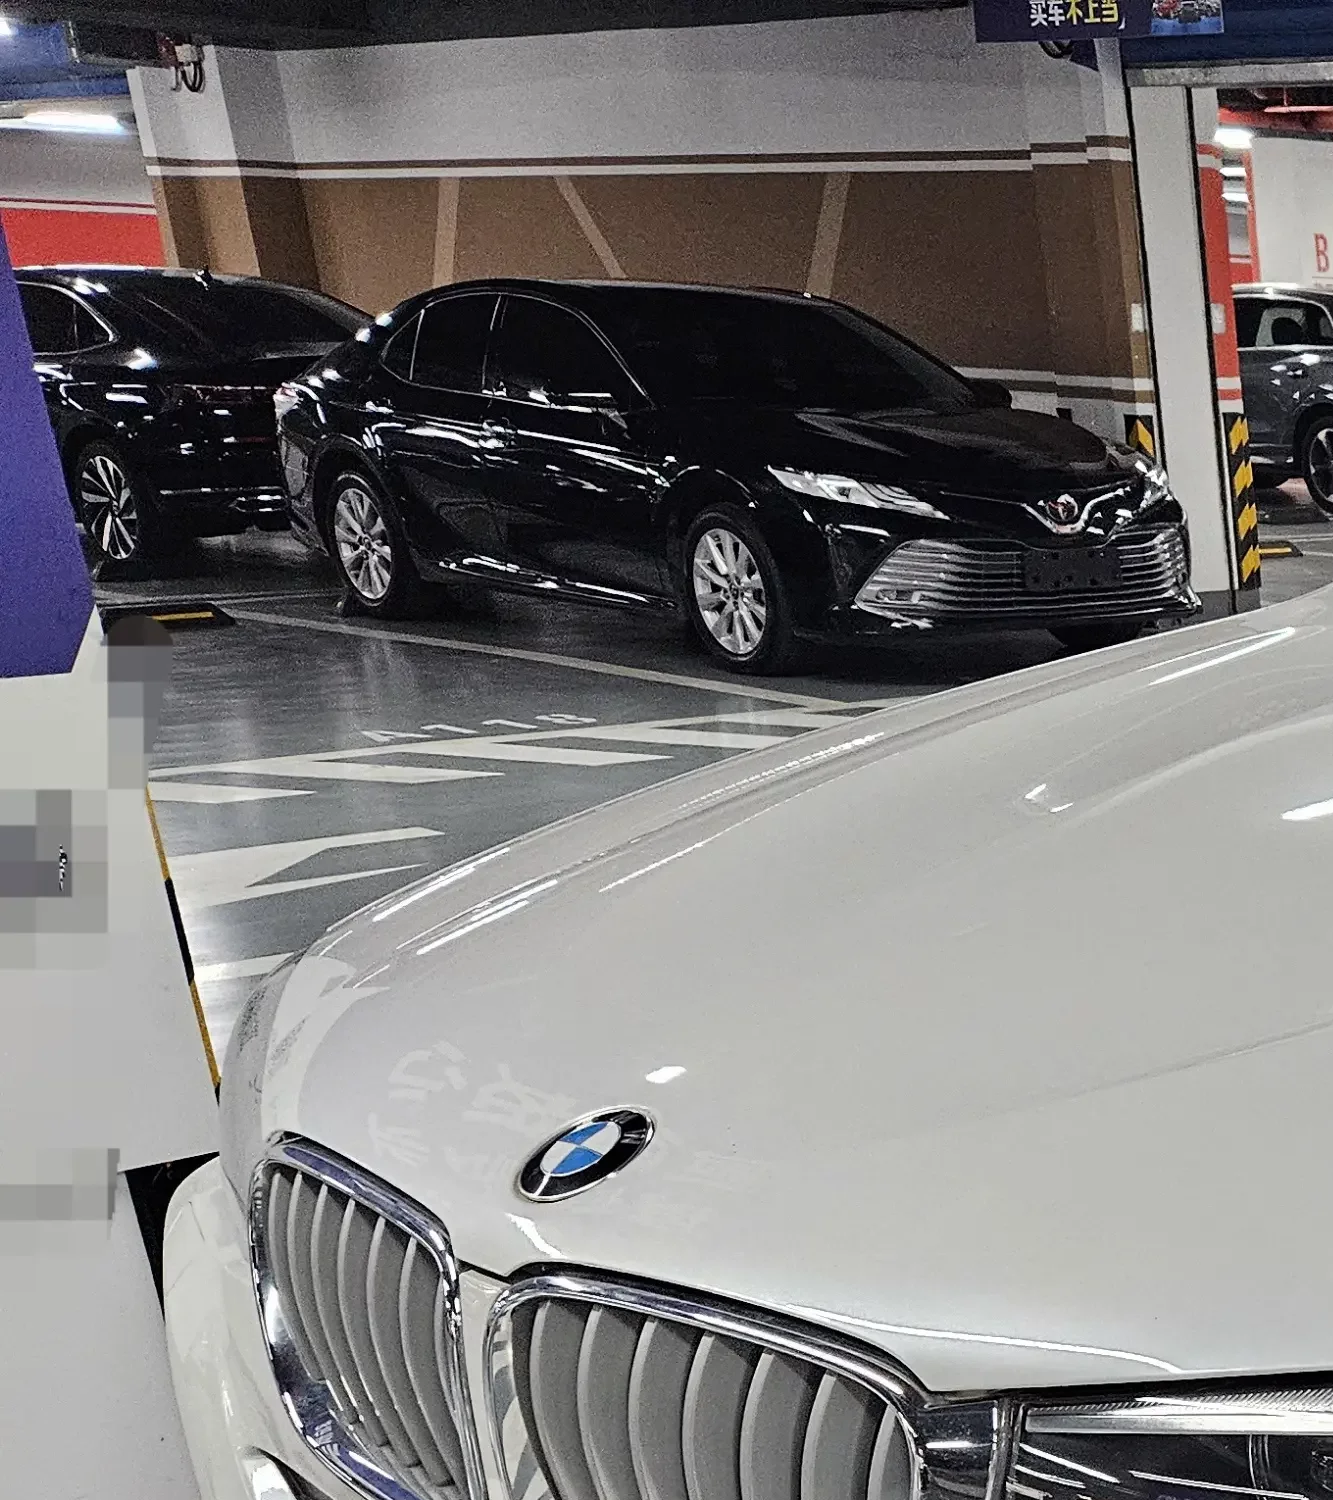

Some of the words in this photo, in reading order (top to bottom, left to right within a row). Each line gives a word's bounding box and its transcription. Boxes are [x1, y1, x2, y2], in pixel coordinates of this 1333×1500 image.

[1029, 0, 1120, 27] 买车不上当
[1313, 232, 1330, 273] B
[360, 713, 597, 743] A118
